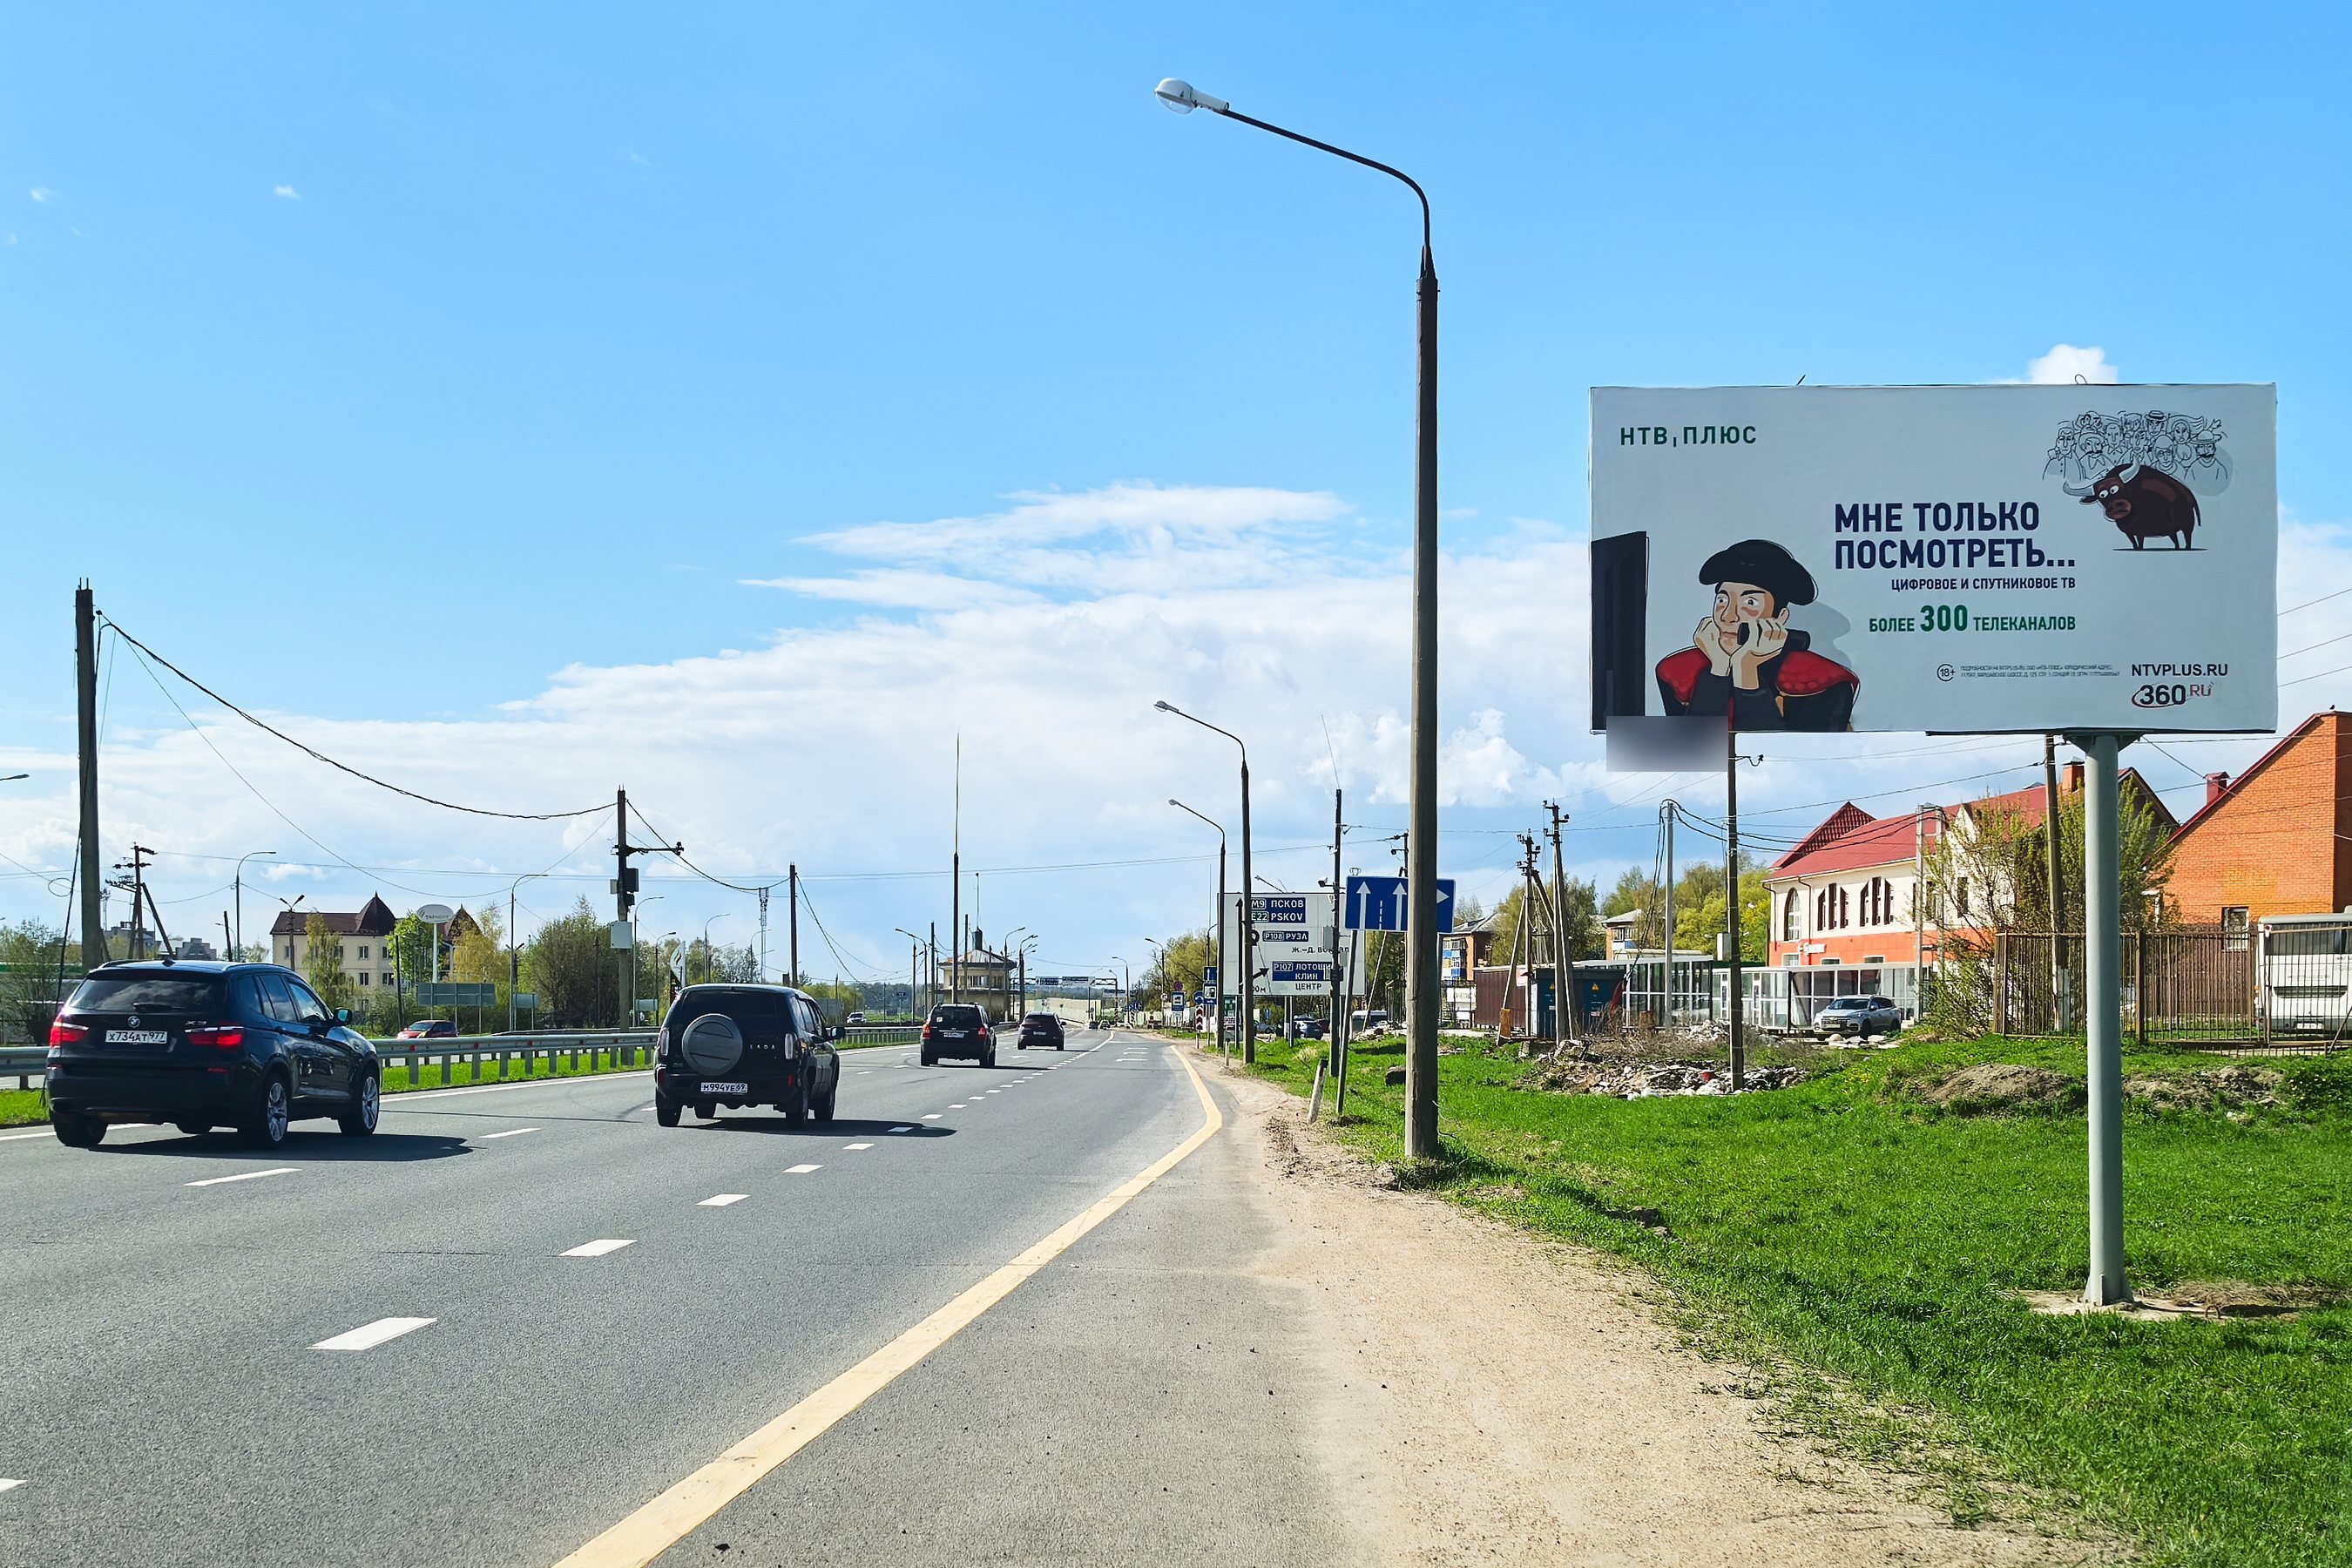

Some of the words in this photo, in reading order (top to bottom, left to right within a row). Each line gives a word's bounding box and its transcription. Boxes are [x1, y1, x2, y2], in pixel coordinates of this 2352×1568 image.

[1835, 503, 1903, 533] МНЕ
[1913, 502, 2039, 532] ТОЛЬКО
[1835, 538, 2076, 570] ПОСМОТРЕТЬ...
[1891, 578, 1957, 592] ЦИФРОВОЕ
[1960, 578, 1969, 590] И
[1972, 578, 2058, 590] СПУТНИКОВОЕ
[2061, 577, 2076, 589] ТВ
[1869, 618, 1915, 632] БОЛЕЕ
[1919, 604, 1968, 632] 300
[1973, 616, 2076, 632] ТЕЛЕКАНАЛОВ
[1939, 667, 1956, 678] 18+
[2131, 663, 2228, 677] NTVPLUS.RU
[1271, 899, 1304, 908] ПСКОВ
[1251, 912, 1267, 921] E22
[1271, 912, 1303, 922] PSKOV
